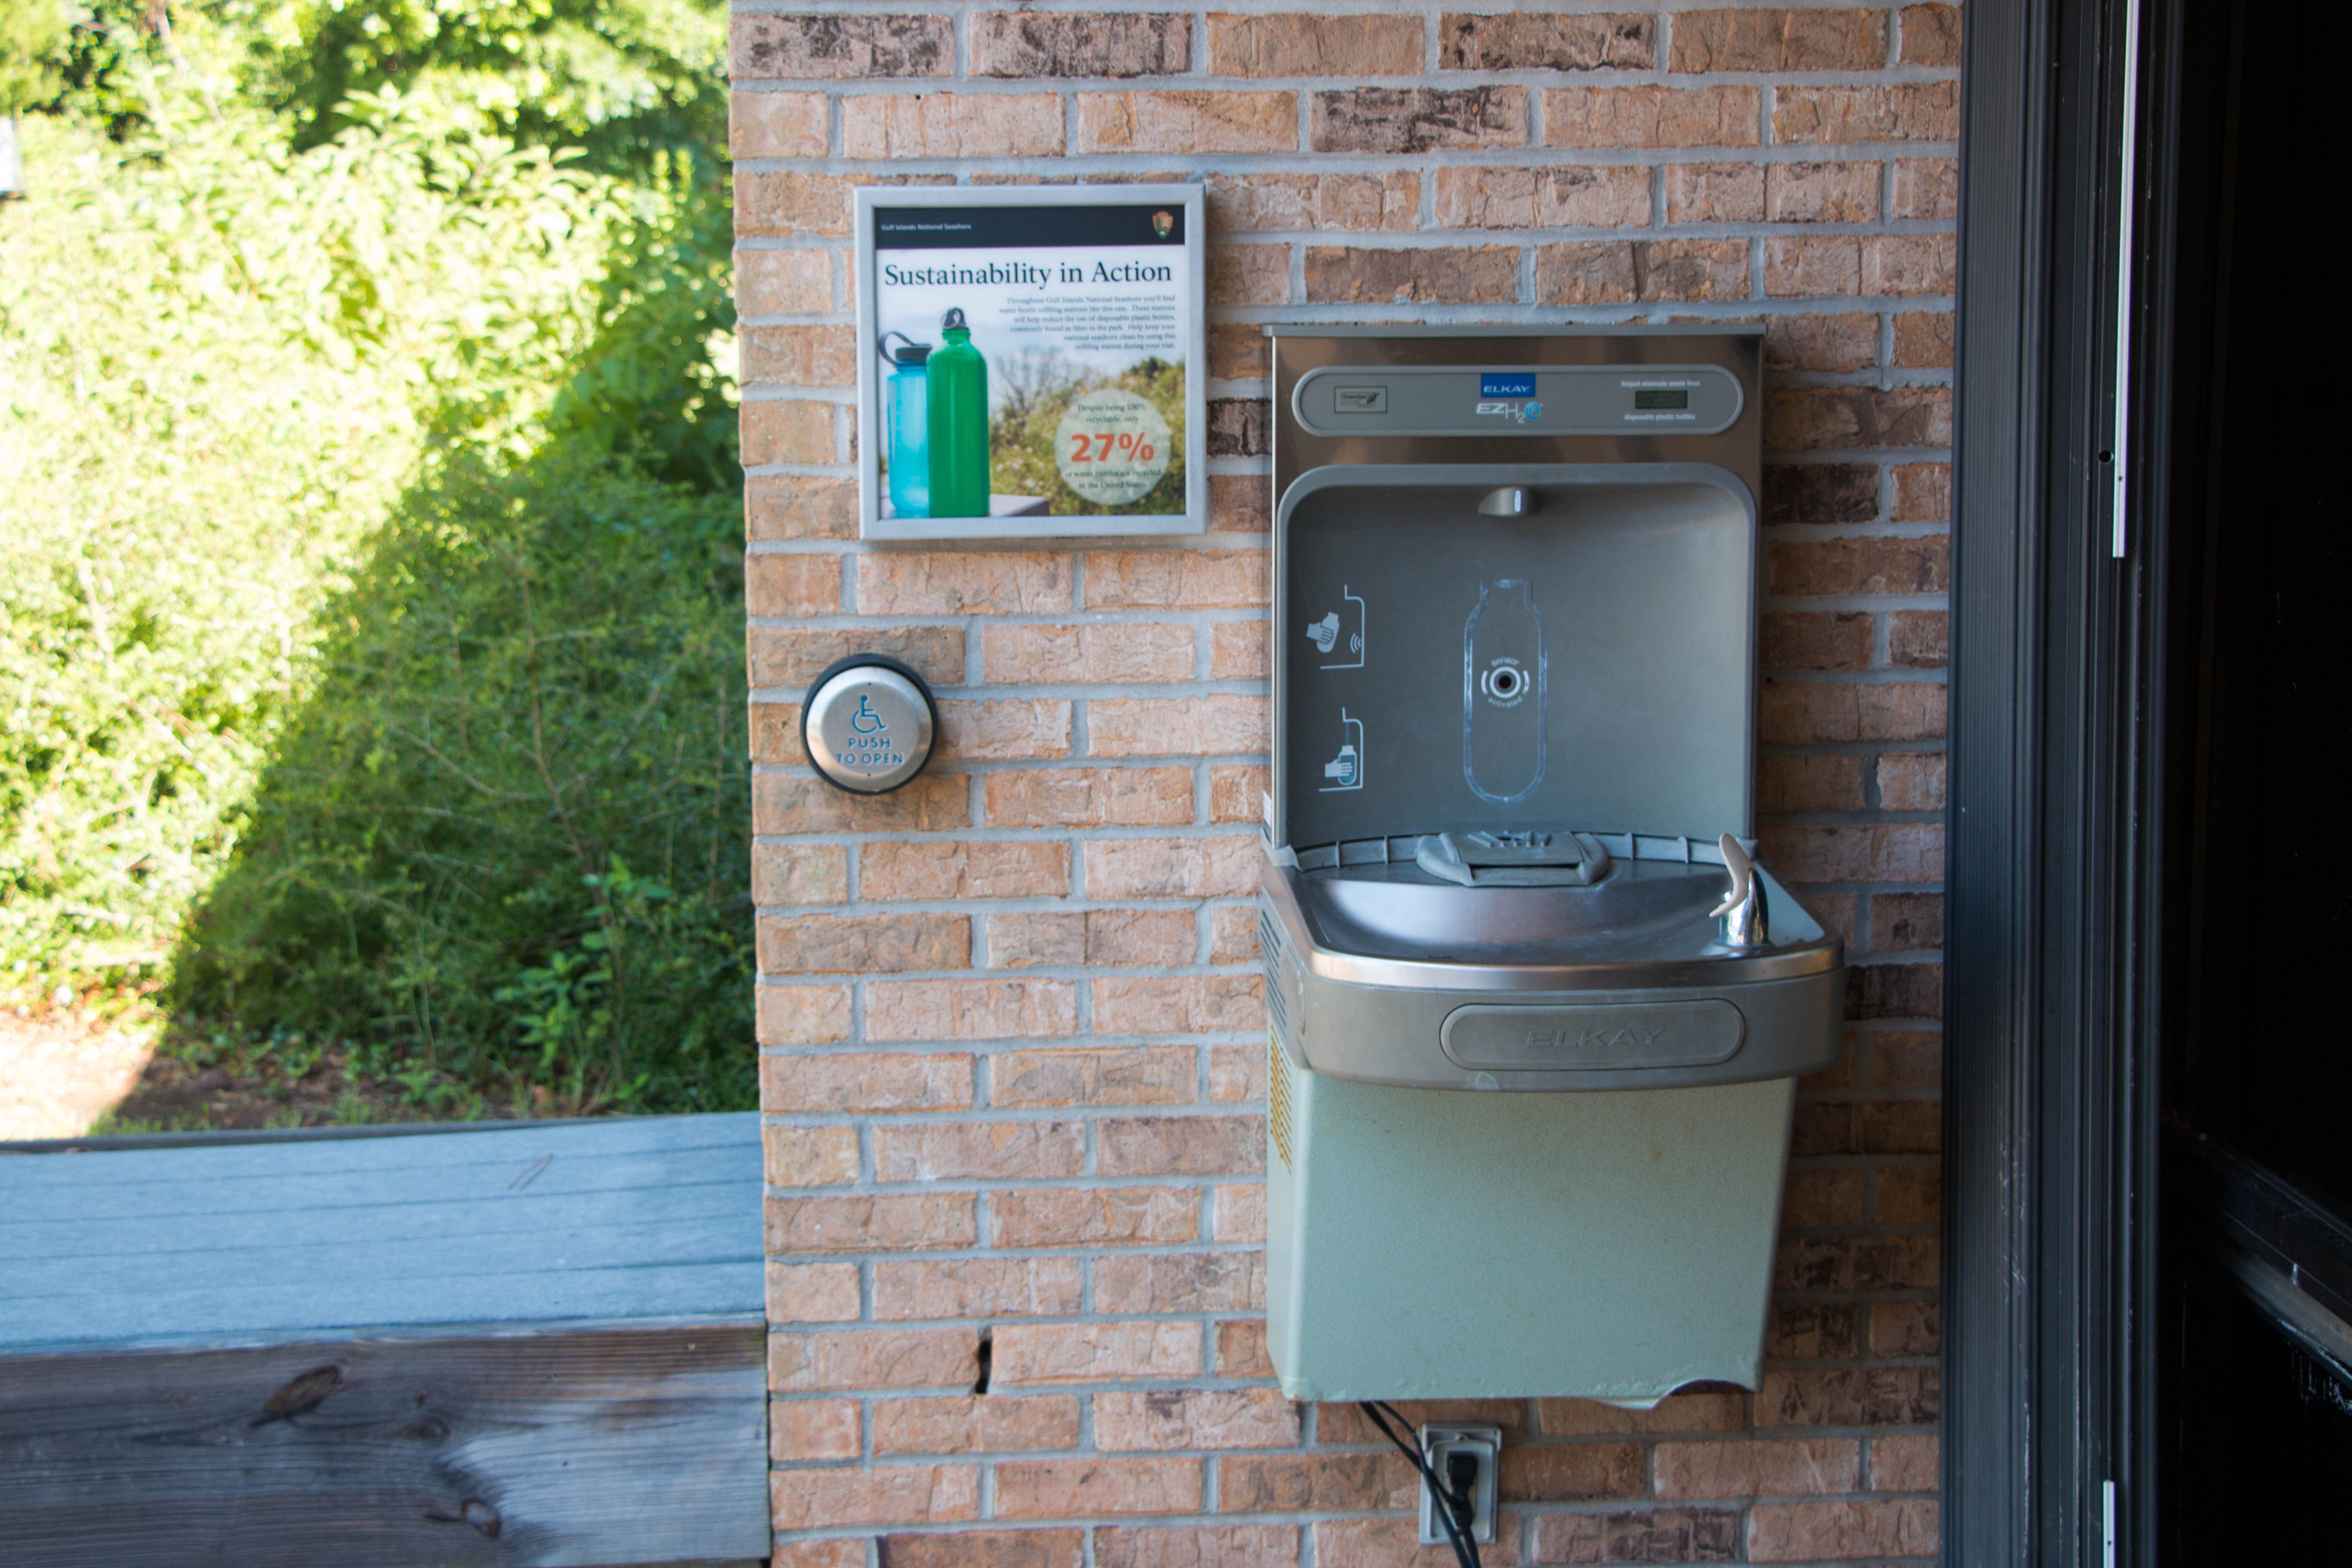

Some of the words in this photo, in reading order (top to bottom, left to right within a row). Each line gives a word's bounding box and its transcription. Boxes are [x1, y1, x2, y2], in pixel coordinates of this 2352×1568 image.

[880, 223, 894, 231] Gulf
[895, 223, 916, 231] Islands
[917, 223, 943, 231] National
[944, 223, 971, 231] Seashore
[885, 262, 1051, 290] Sustainability
[1060, 262, 1083, 283] in
[1092, 260, 1172, 282] Action
[1077, 403, 1105, 412] Despite
[1124, 415, 1138, 424] only
[1071, 432, 1155, 462] 27%
[1132, 469, 1161, 477] recycled
[1491, 657, 1520, 667] sensor
[1487, 695, 1522, 708] activated
[848, 737, 891, 749] PUSH
[836, 753, 856, 764] TO
[861, 753, 903, 764] OPEN
[1527, 1027, 1666, 1047] ELKAY
